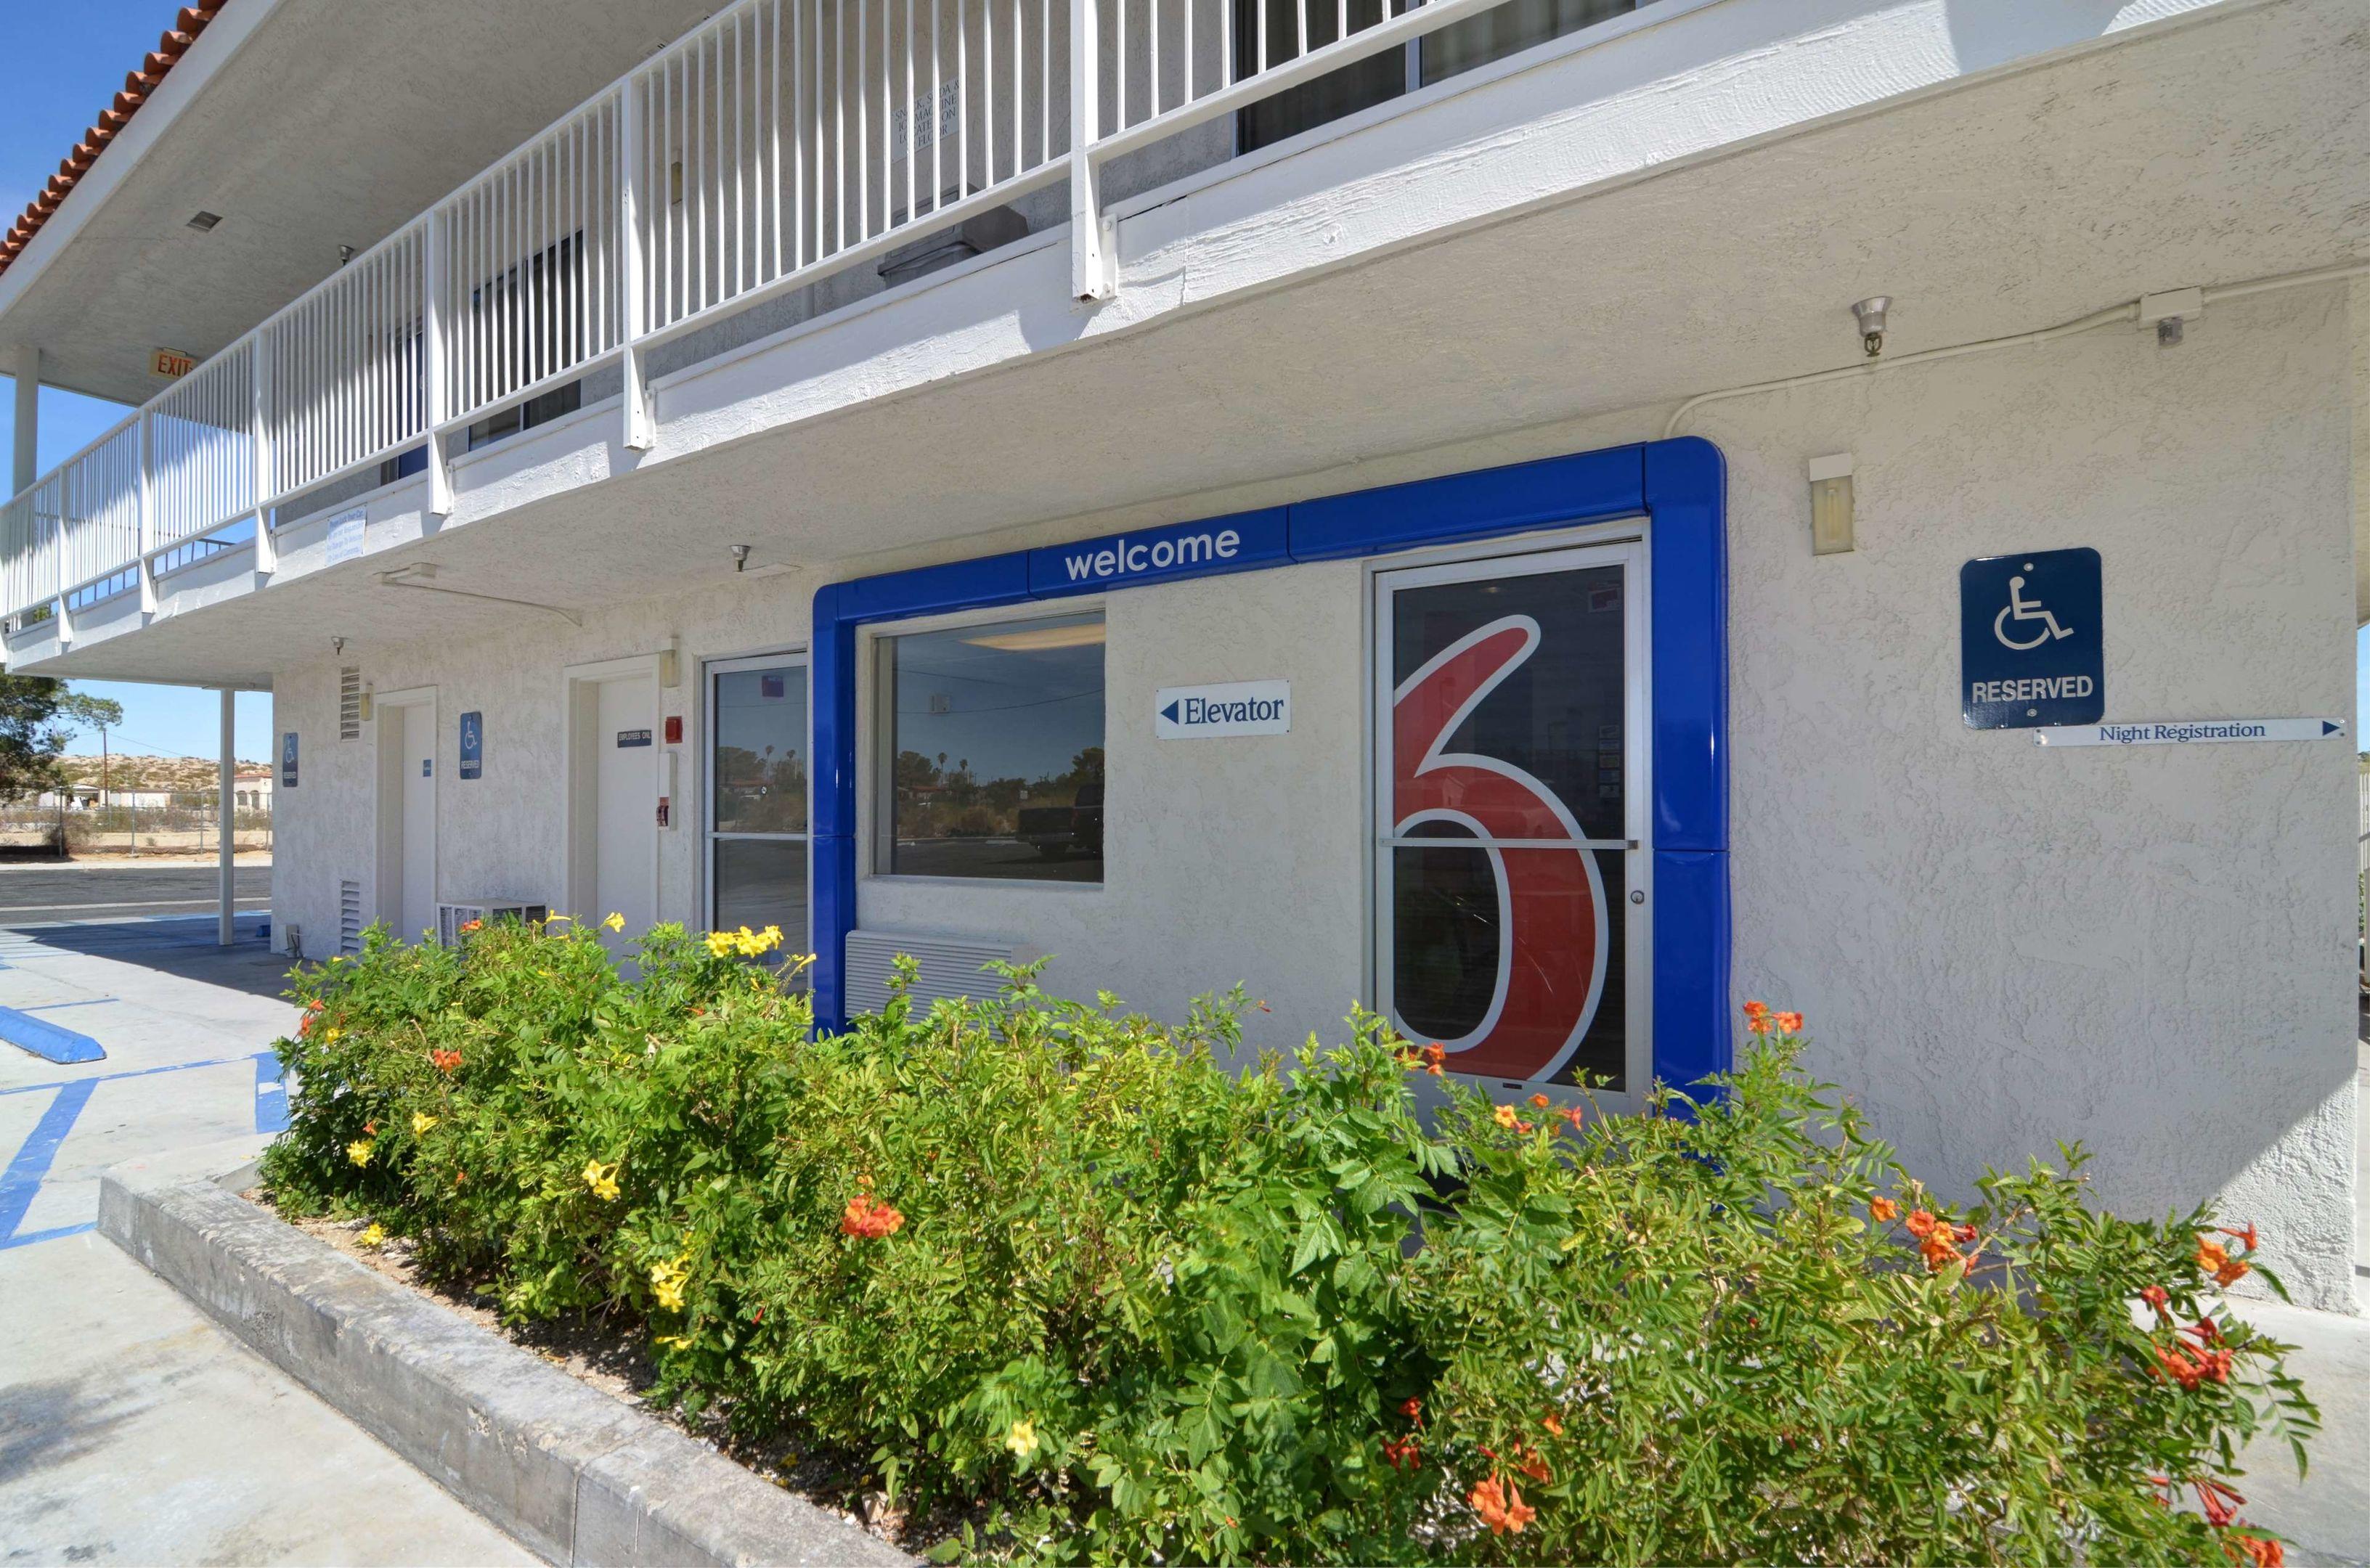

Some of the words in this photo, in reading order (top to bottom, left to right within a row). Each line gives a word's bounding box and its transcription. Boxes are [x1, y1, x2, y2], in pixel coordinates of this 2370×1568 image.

[915, 94, 957, 123] MACINE
[158, 354, 192, 376] EXIT
[1065, 530, 1239, 581] welcome
[1972, 676, 2093, 703] RESERVED
[1184, 697, 1284, 724] Elevator
[2100, 726, 2150, 744] Night
[2154, 722, 2265, 743] Registration
